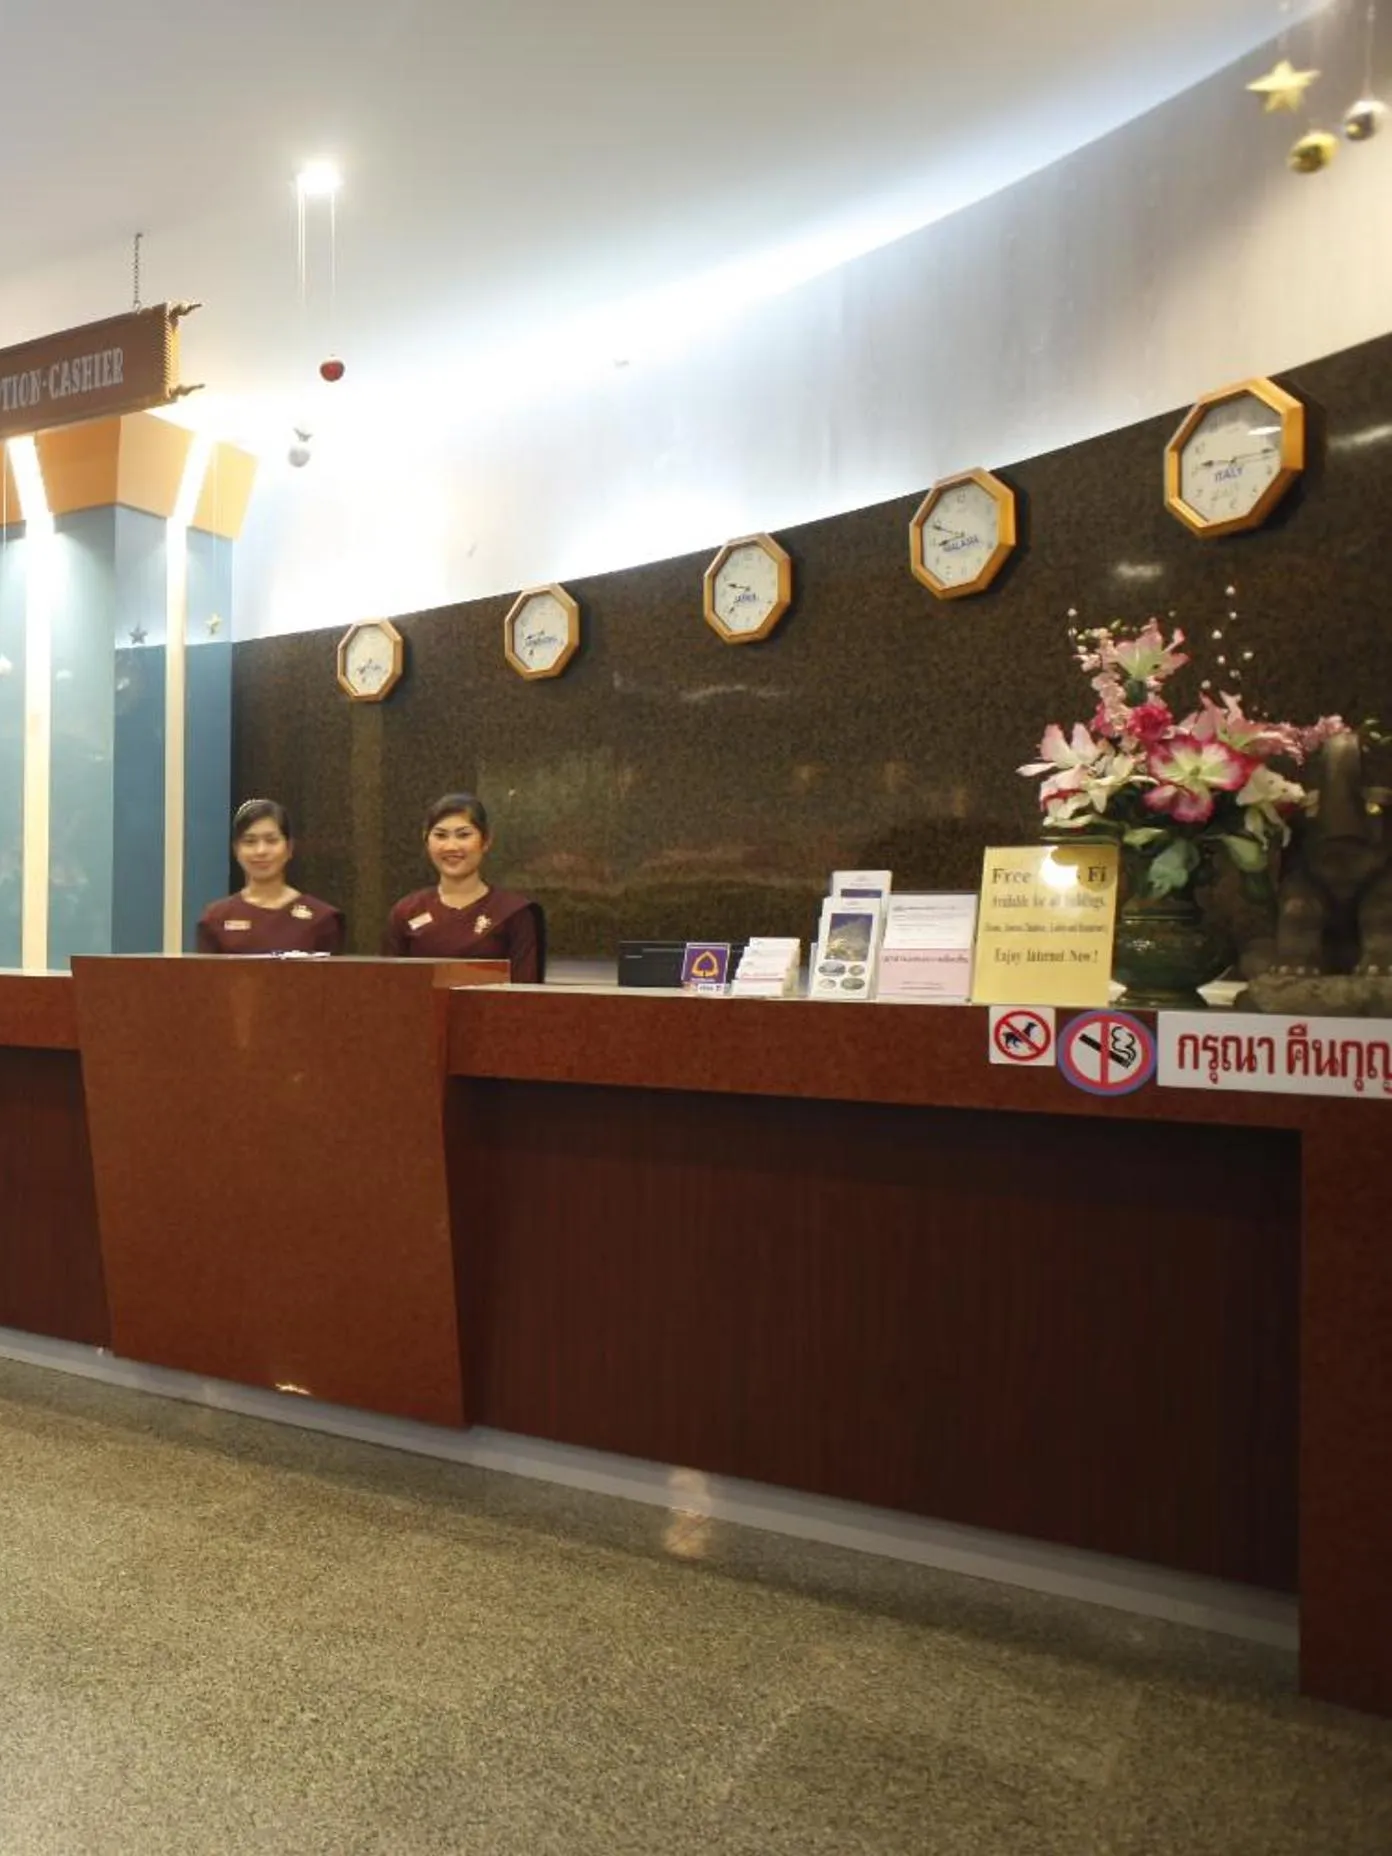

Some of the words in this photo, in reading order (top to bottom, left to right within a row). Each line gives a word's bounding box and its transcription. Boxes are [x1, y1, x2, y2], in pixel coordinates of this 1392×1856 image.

[991, 868, 1031, 885] Free
[995, 948, 1021, 966] Enjoy
[1177, 1033, 1275, 1085] กรุณา
